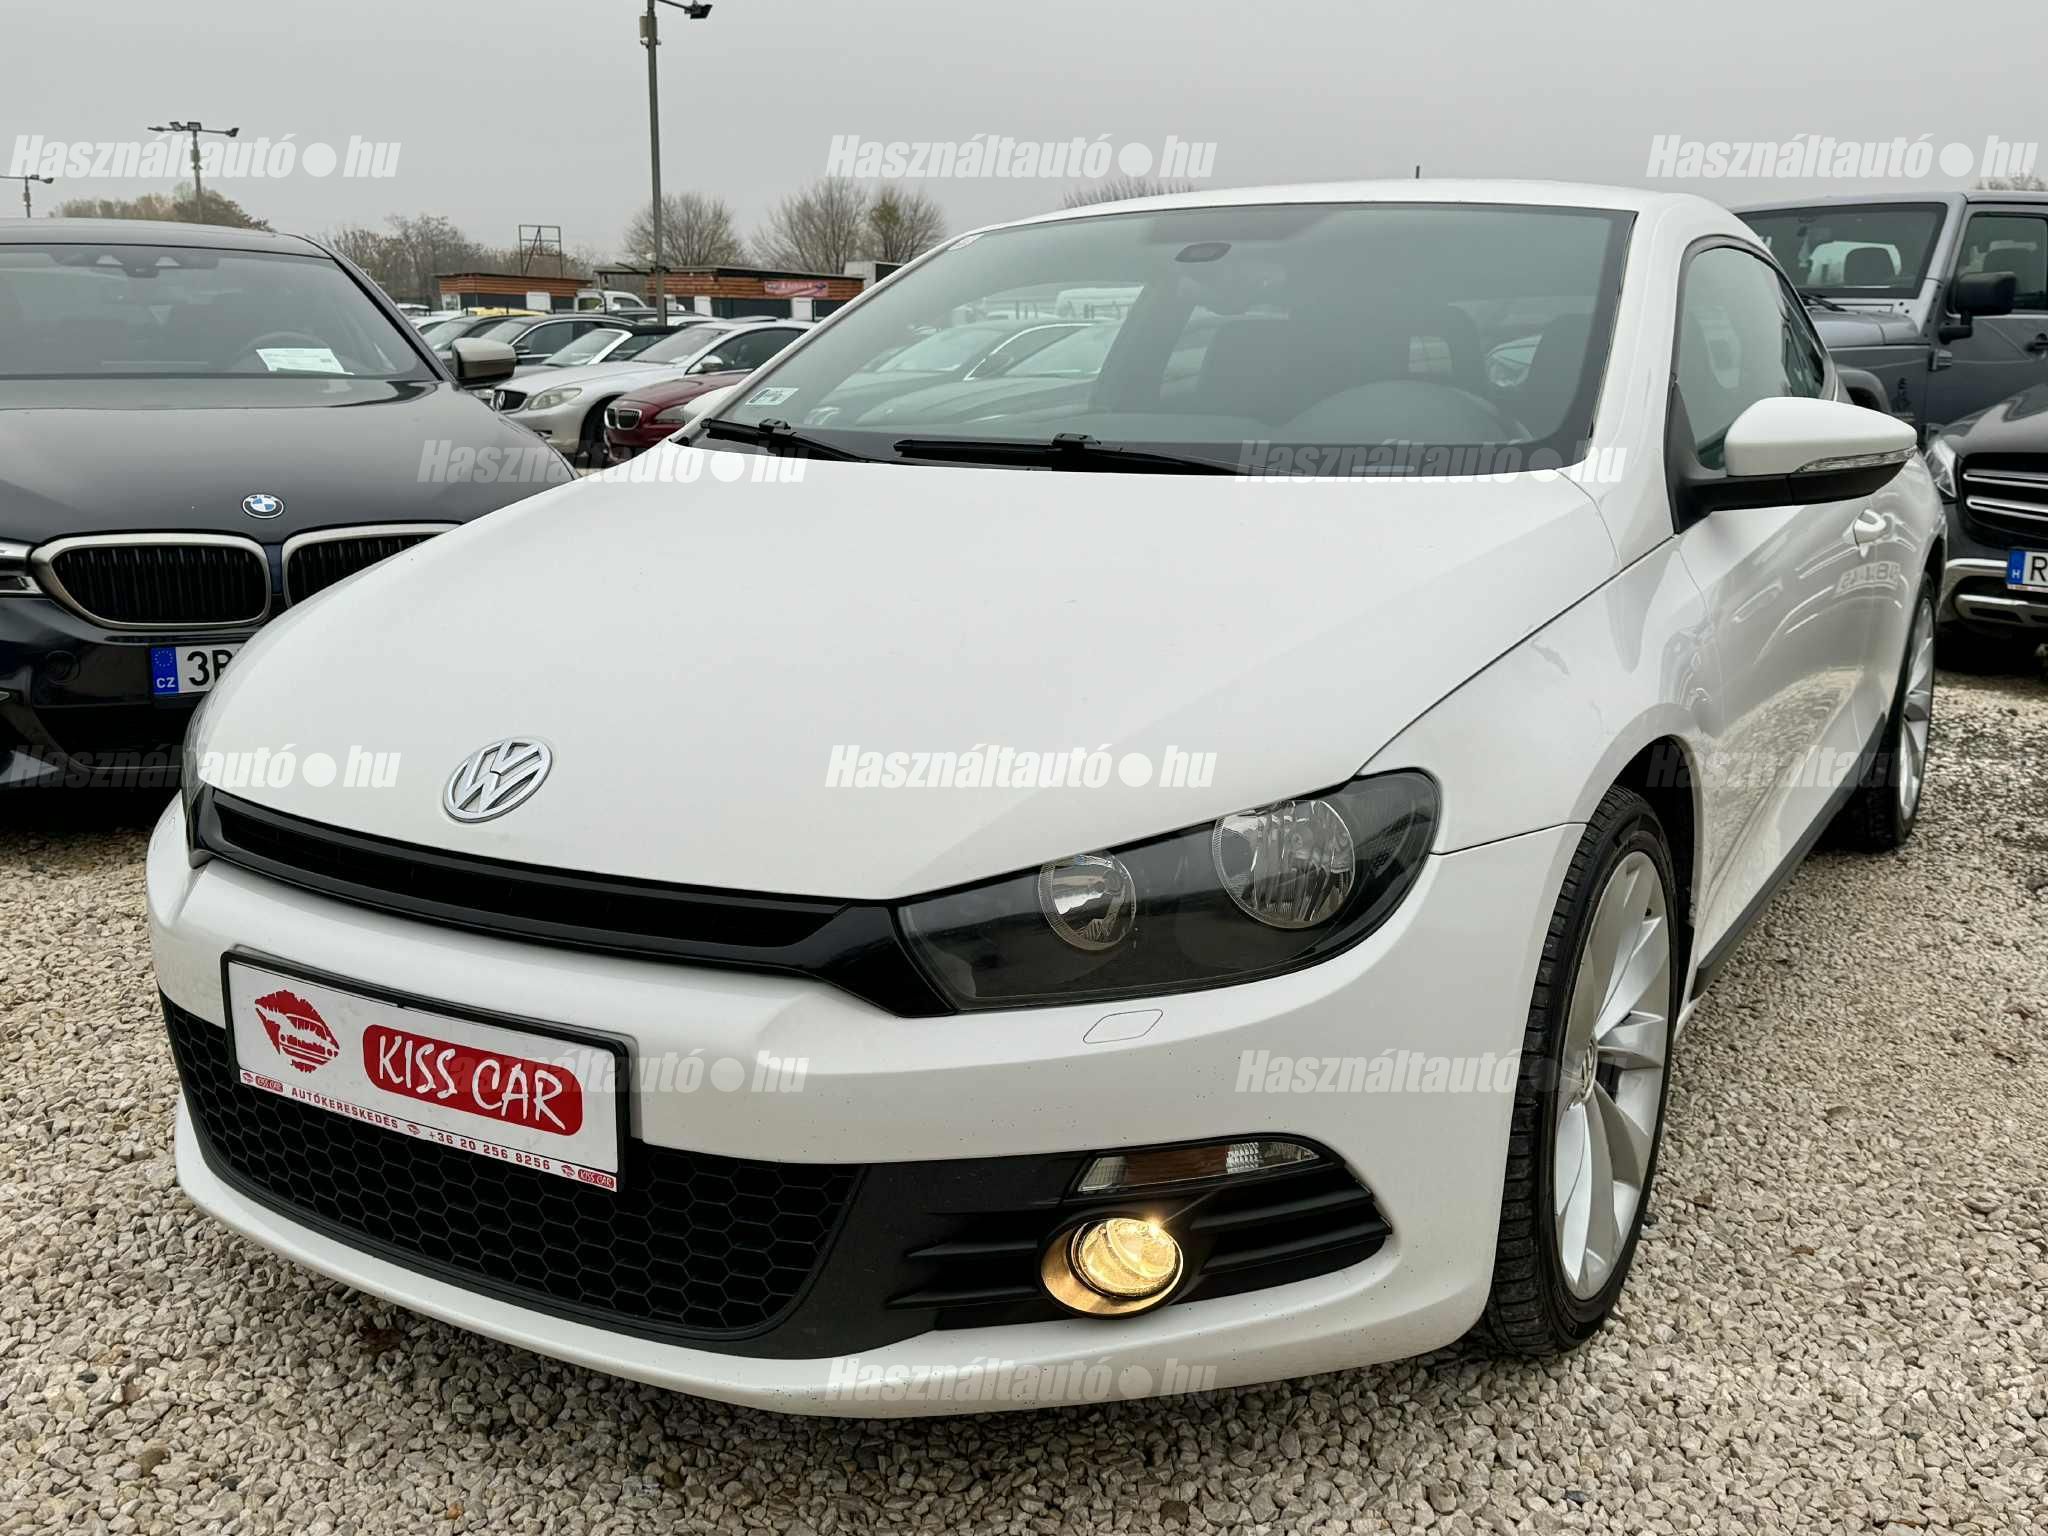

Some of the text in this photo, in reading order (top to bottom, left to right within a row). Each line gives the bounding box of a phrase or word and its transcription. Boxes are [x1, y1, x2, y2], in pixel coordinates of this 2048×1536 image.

[2012, 569, 2021, 579] H
[156, 677, 176, 689] CZ
[379, 1035, 566, 1130] KISS CAR
[291, 1087, 399, 1129] AUTÓKERESKEDÉS
[429, 1132, 551, 1170] +36 20 256 8256
